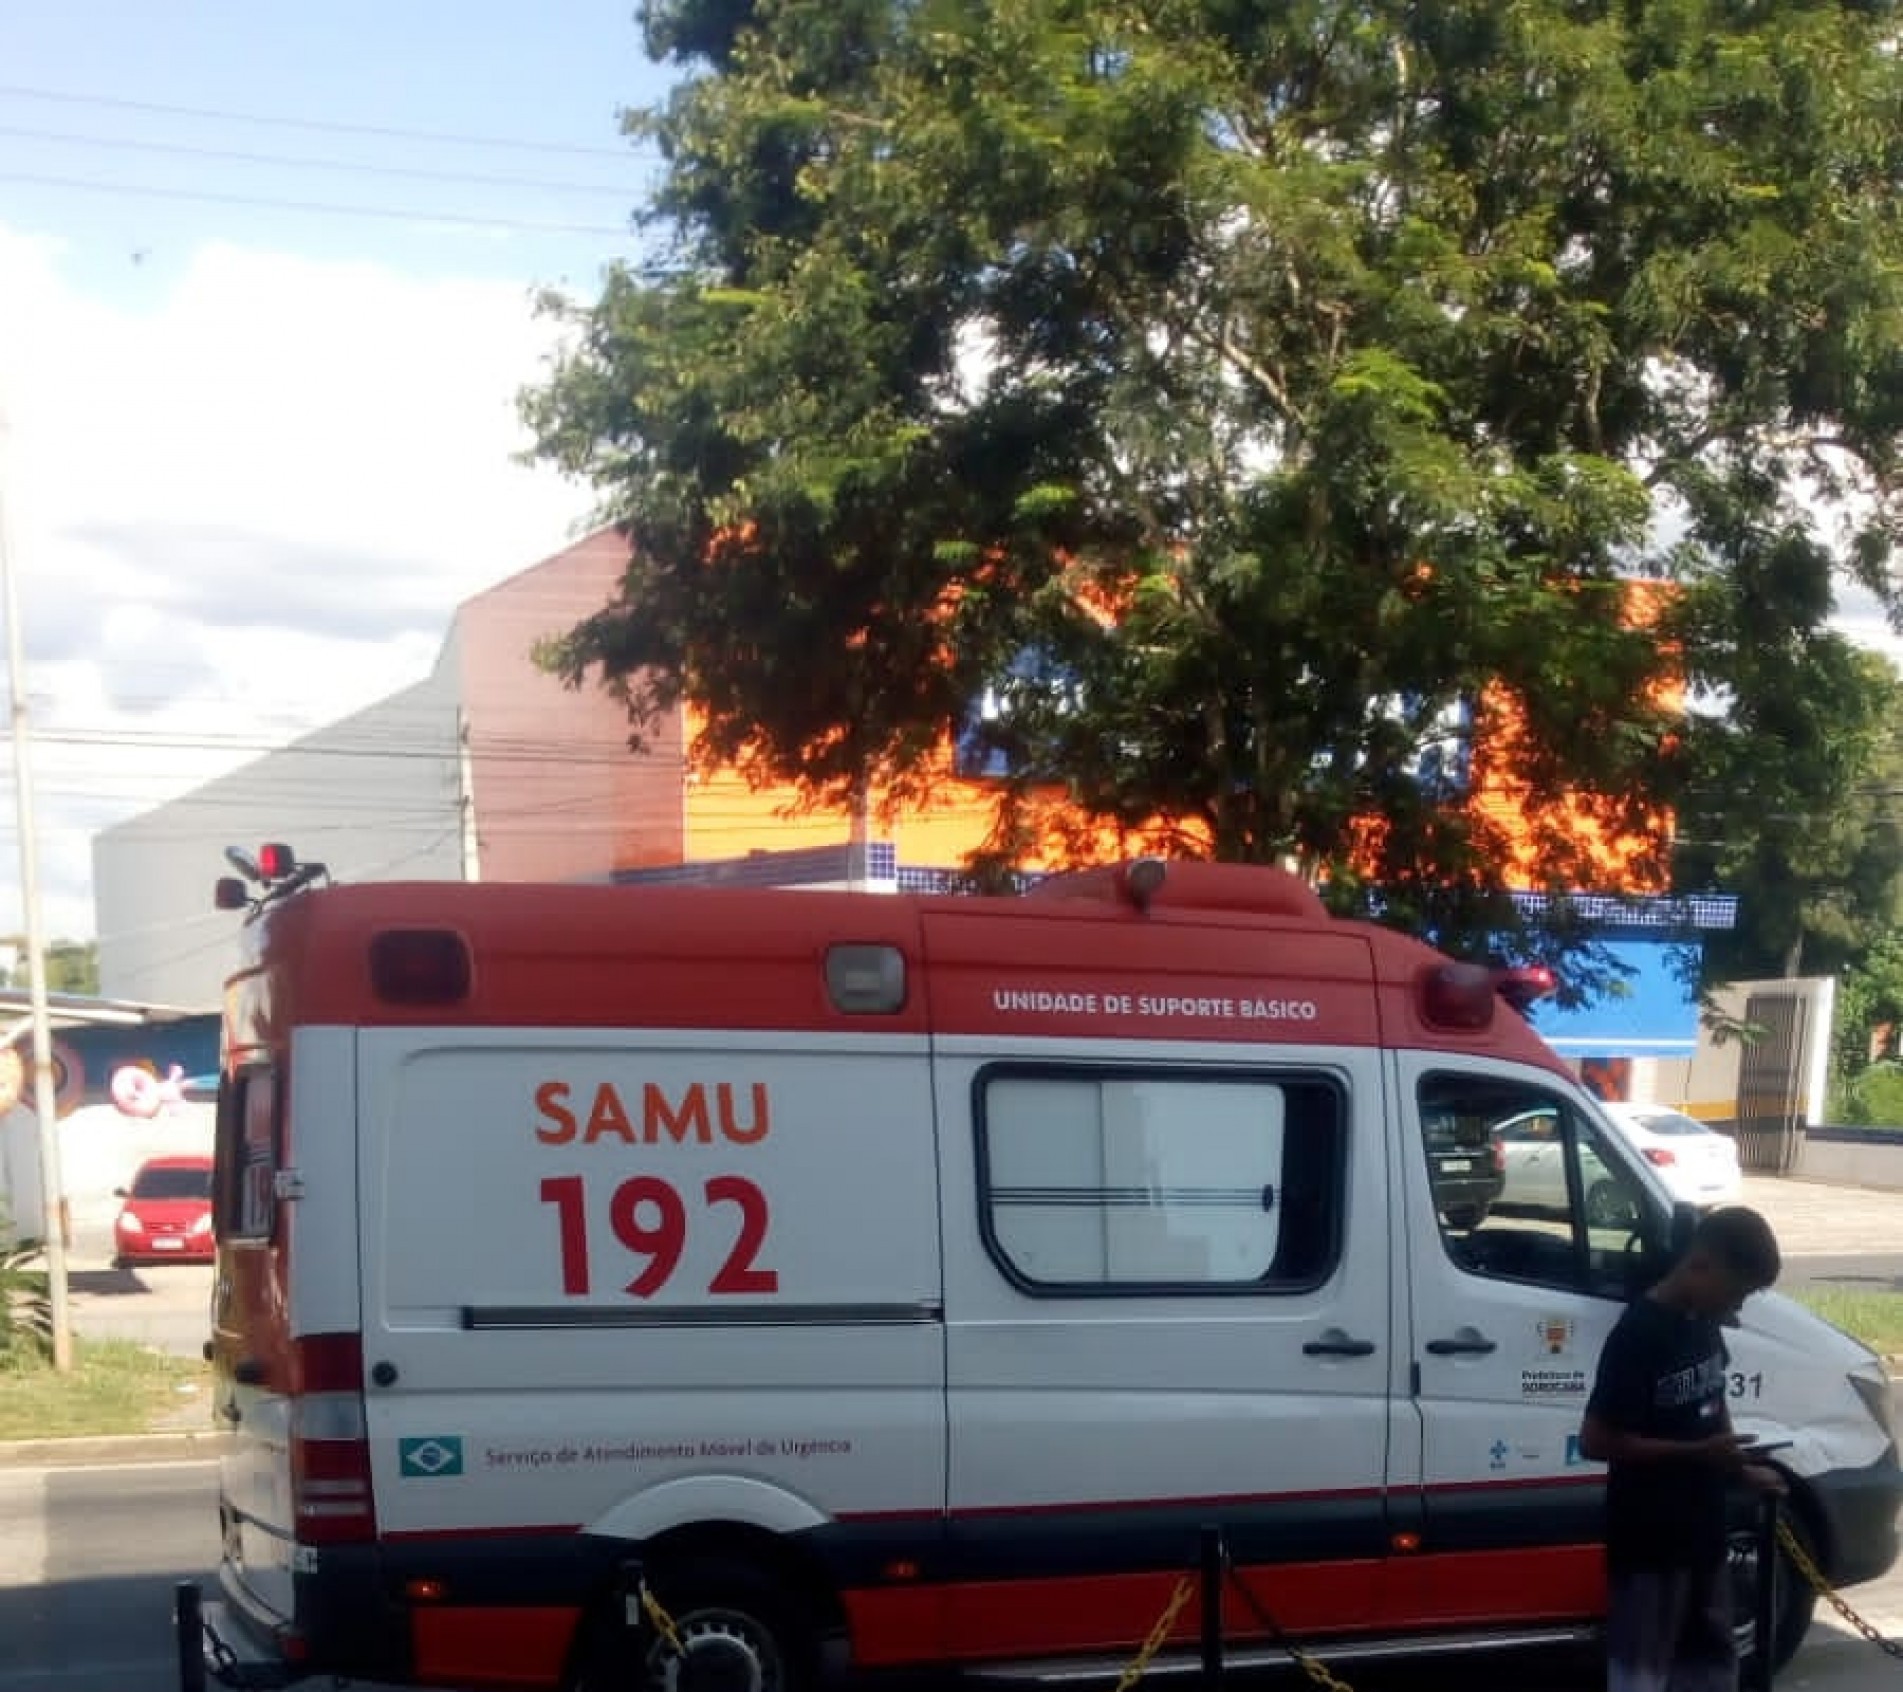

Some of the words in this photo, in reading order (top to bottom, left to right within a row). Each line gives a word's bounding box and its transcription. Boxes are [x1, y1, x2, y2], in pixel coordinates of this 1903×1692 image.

[993, 989, 1097, 1014] UNIDADE
[1103, 994, 1132, 1014] DE
[1138, 996, 1236, 1017] SUPORTE
[1239, 996, 1317, 1021] BÁSICO
[535, 1081, 769, 1145] SAMU
[540, 1174, 779, 1299] 192
